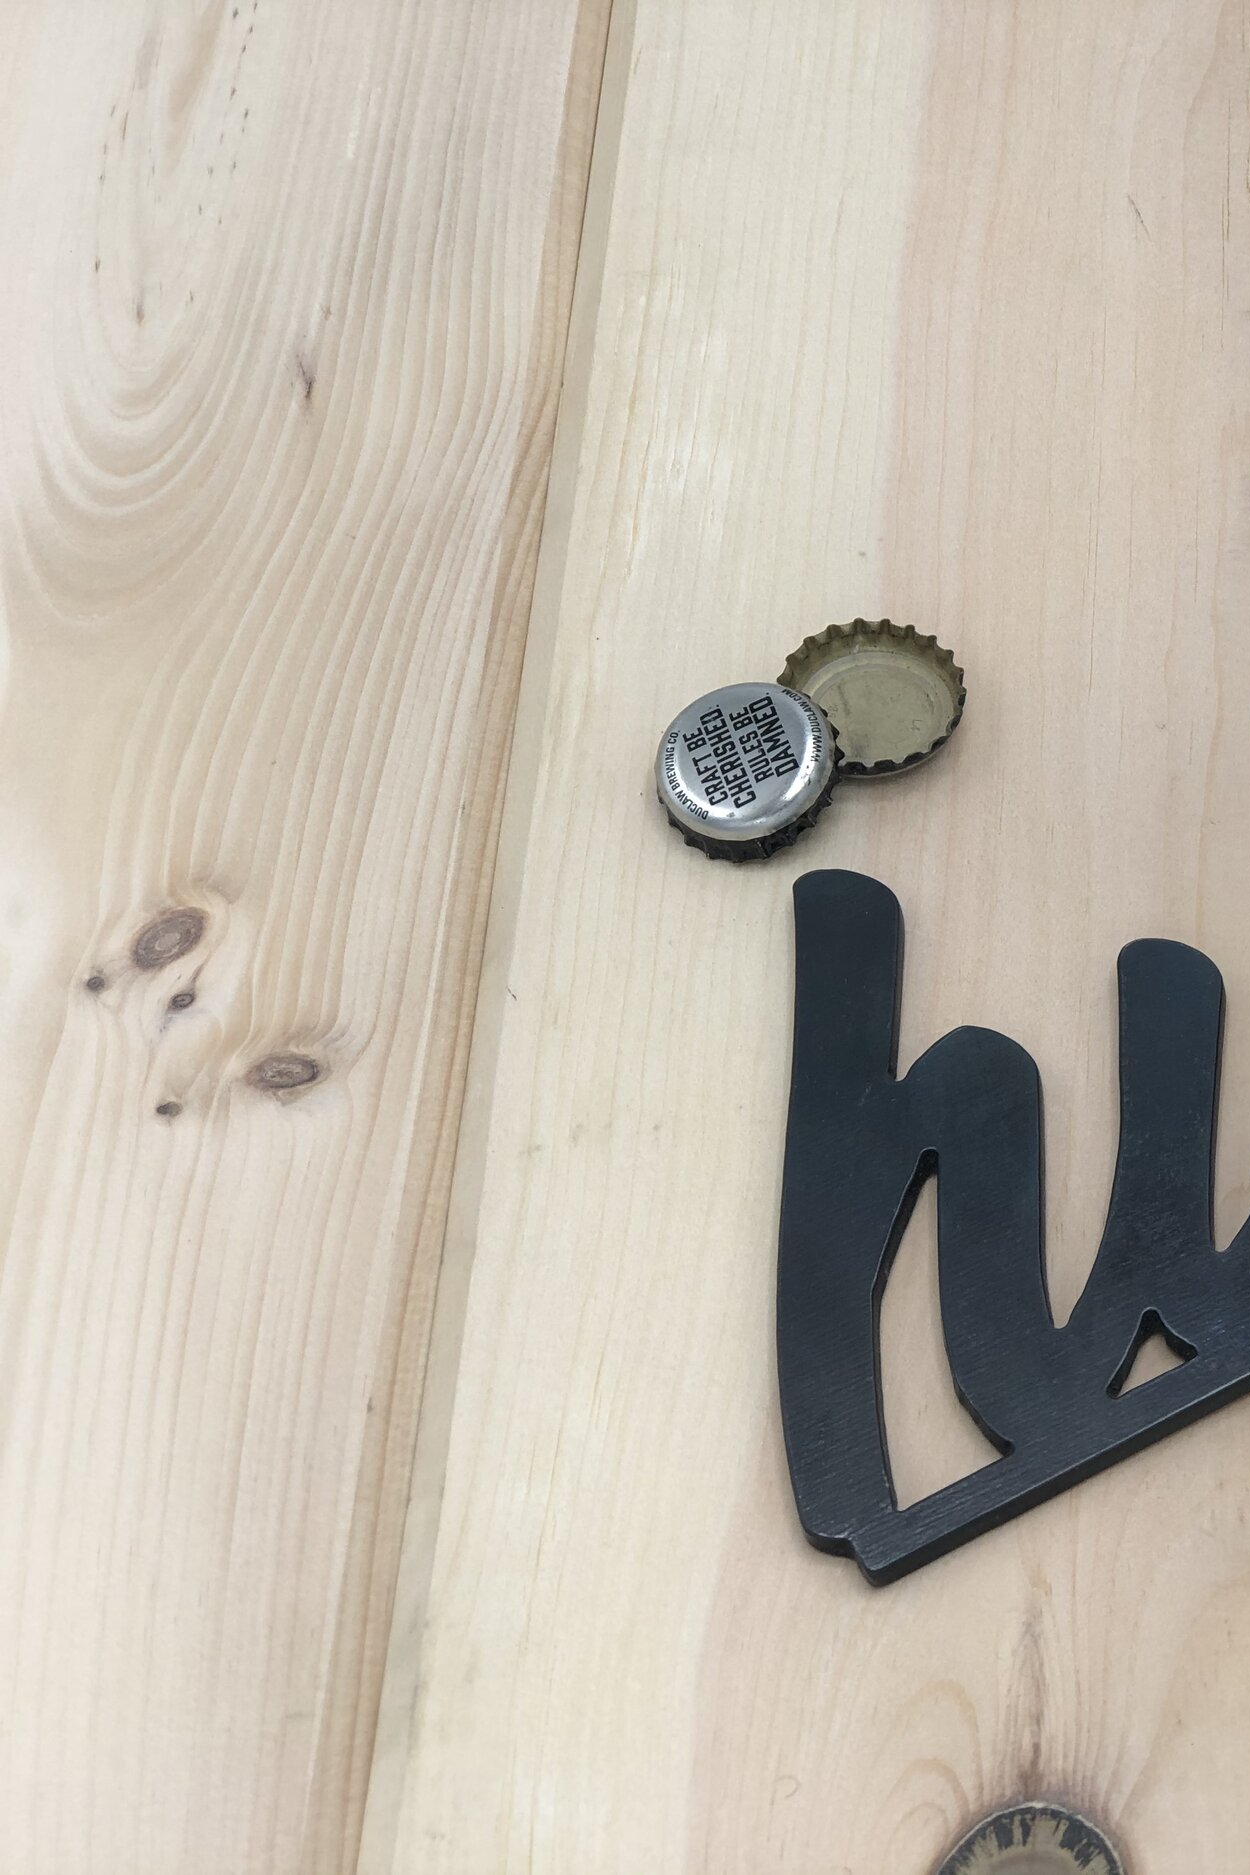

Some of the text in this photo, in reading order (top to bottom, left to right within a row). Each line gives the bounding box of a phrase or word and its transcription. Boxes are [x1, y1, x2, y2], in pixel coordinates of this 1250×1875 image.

[682, 727, 728, 806] CRAFT BE
[699, 704, 757, 809] CHERISHED.
[728, 706, 774, 783] RULES BE
[748, 691, 800, 778] DAMNED.
[781, 688, 822, 762] WWW.DUCLAW.COM
[665, 729, 709, 820] DUCLAW BREWING CO.
